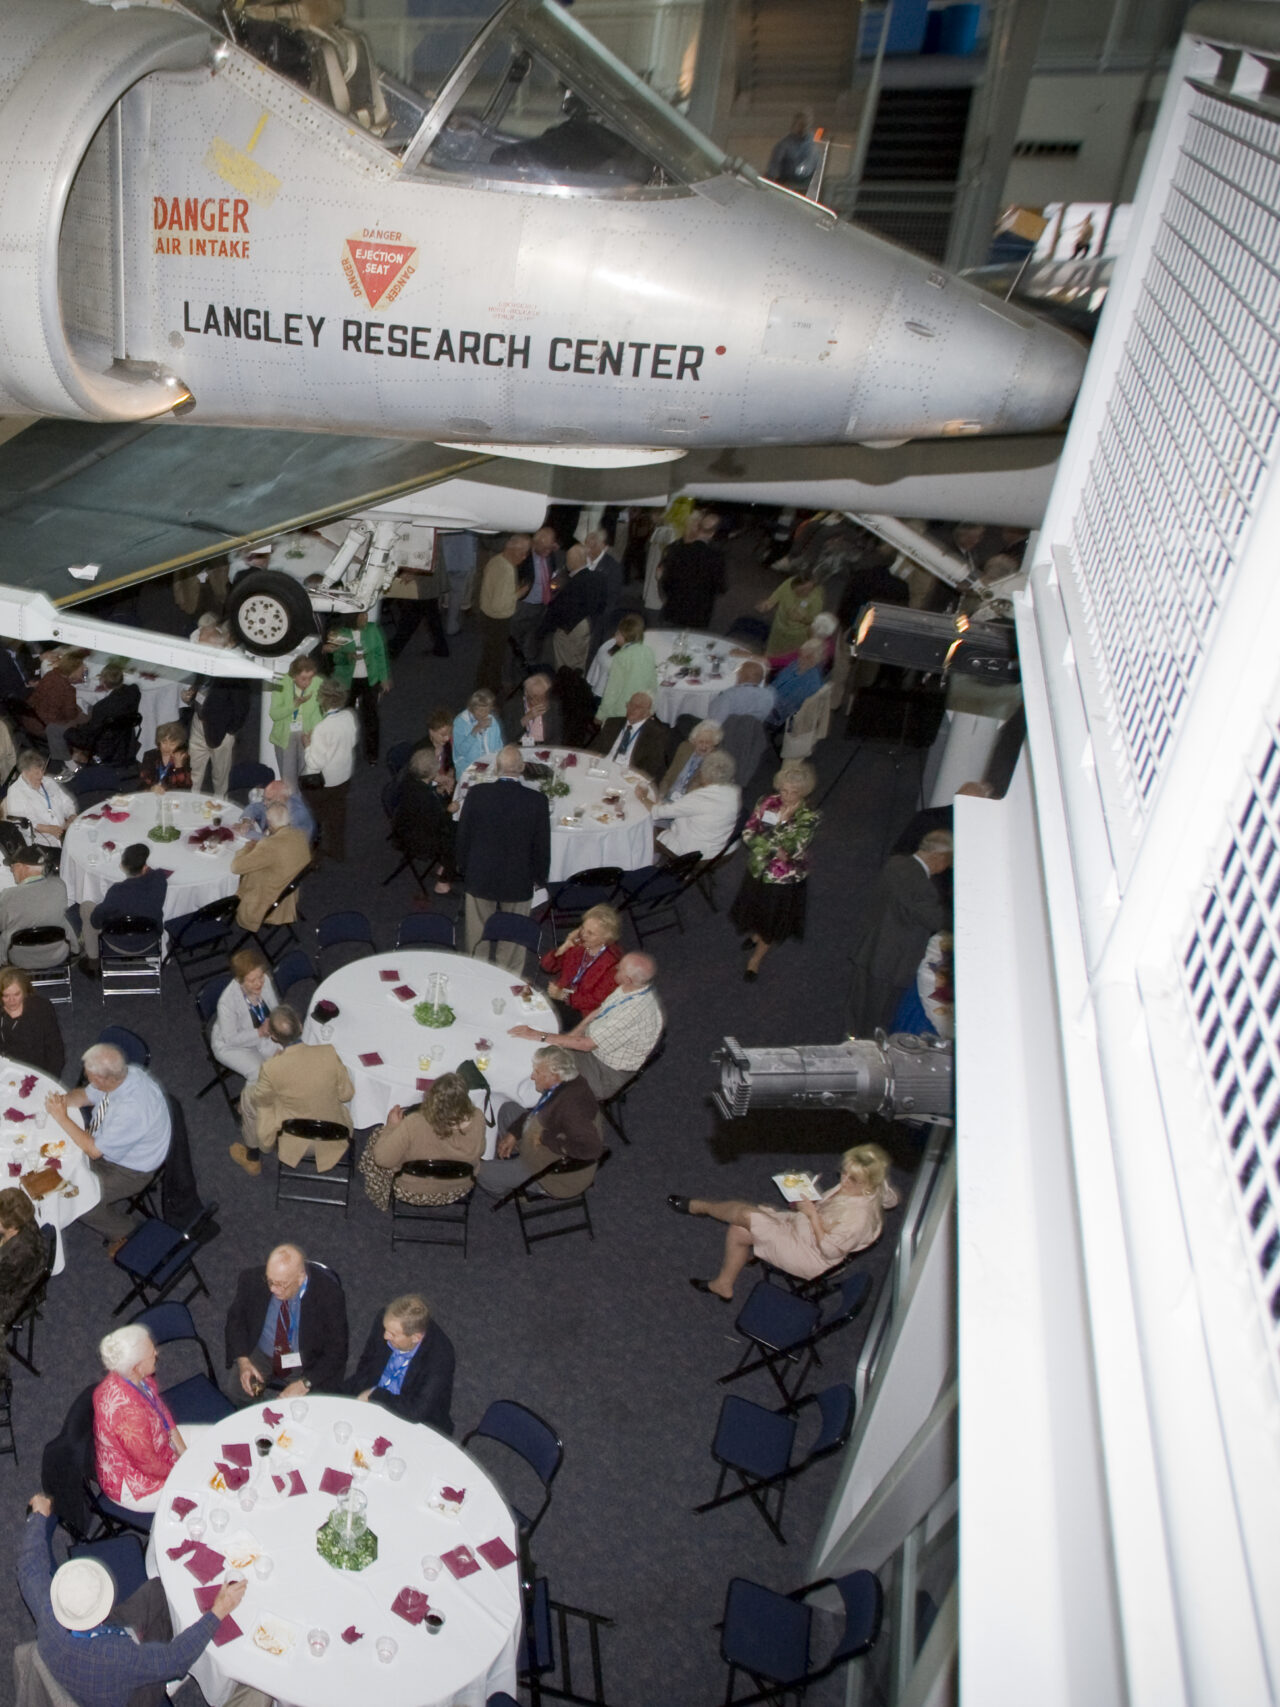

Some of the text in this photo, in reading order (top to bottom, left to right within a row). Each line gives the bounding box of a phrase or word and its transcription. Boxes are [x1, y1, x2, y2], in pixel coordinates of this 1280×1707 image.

[153, 196, 250, 233] DANGER
[155, 237, 250, 259] AIR INTAKE
[362, 227, 402, 241] DANGER
[355, 248, 404, 264] EJECTION
[365, 263, 391, 276] SEAT
[341, 257, 362, 298] DANGER
[385, 265, 416, 302] DANGER
[184, 300, 705, 381] LANGLEY RESEARCH CENTER
